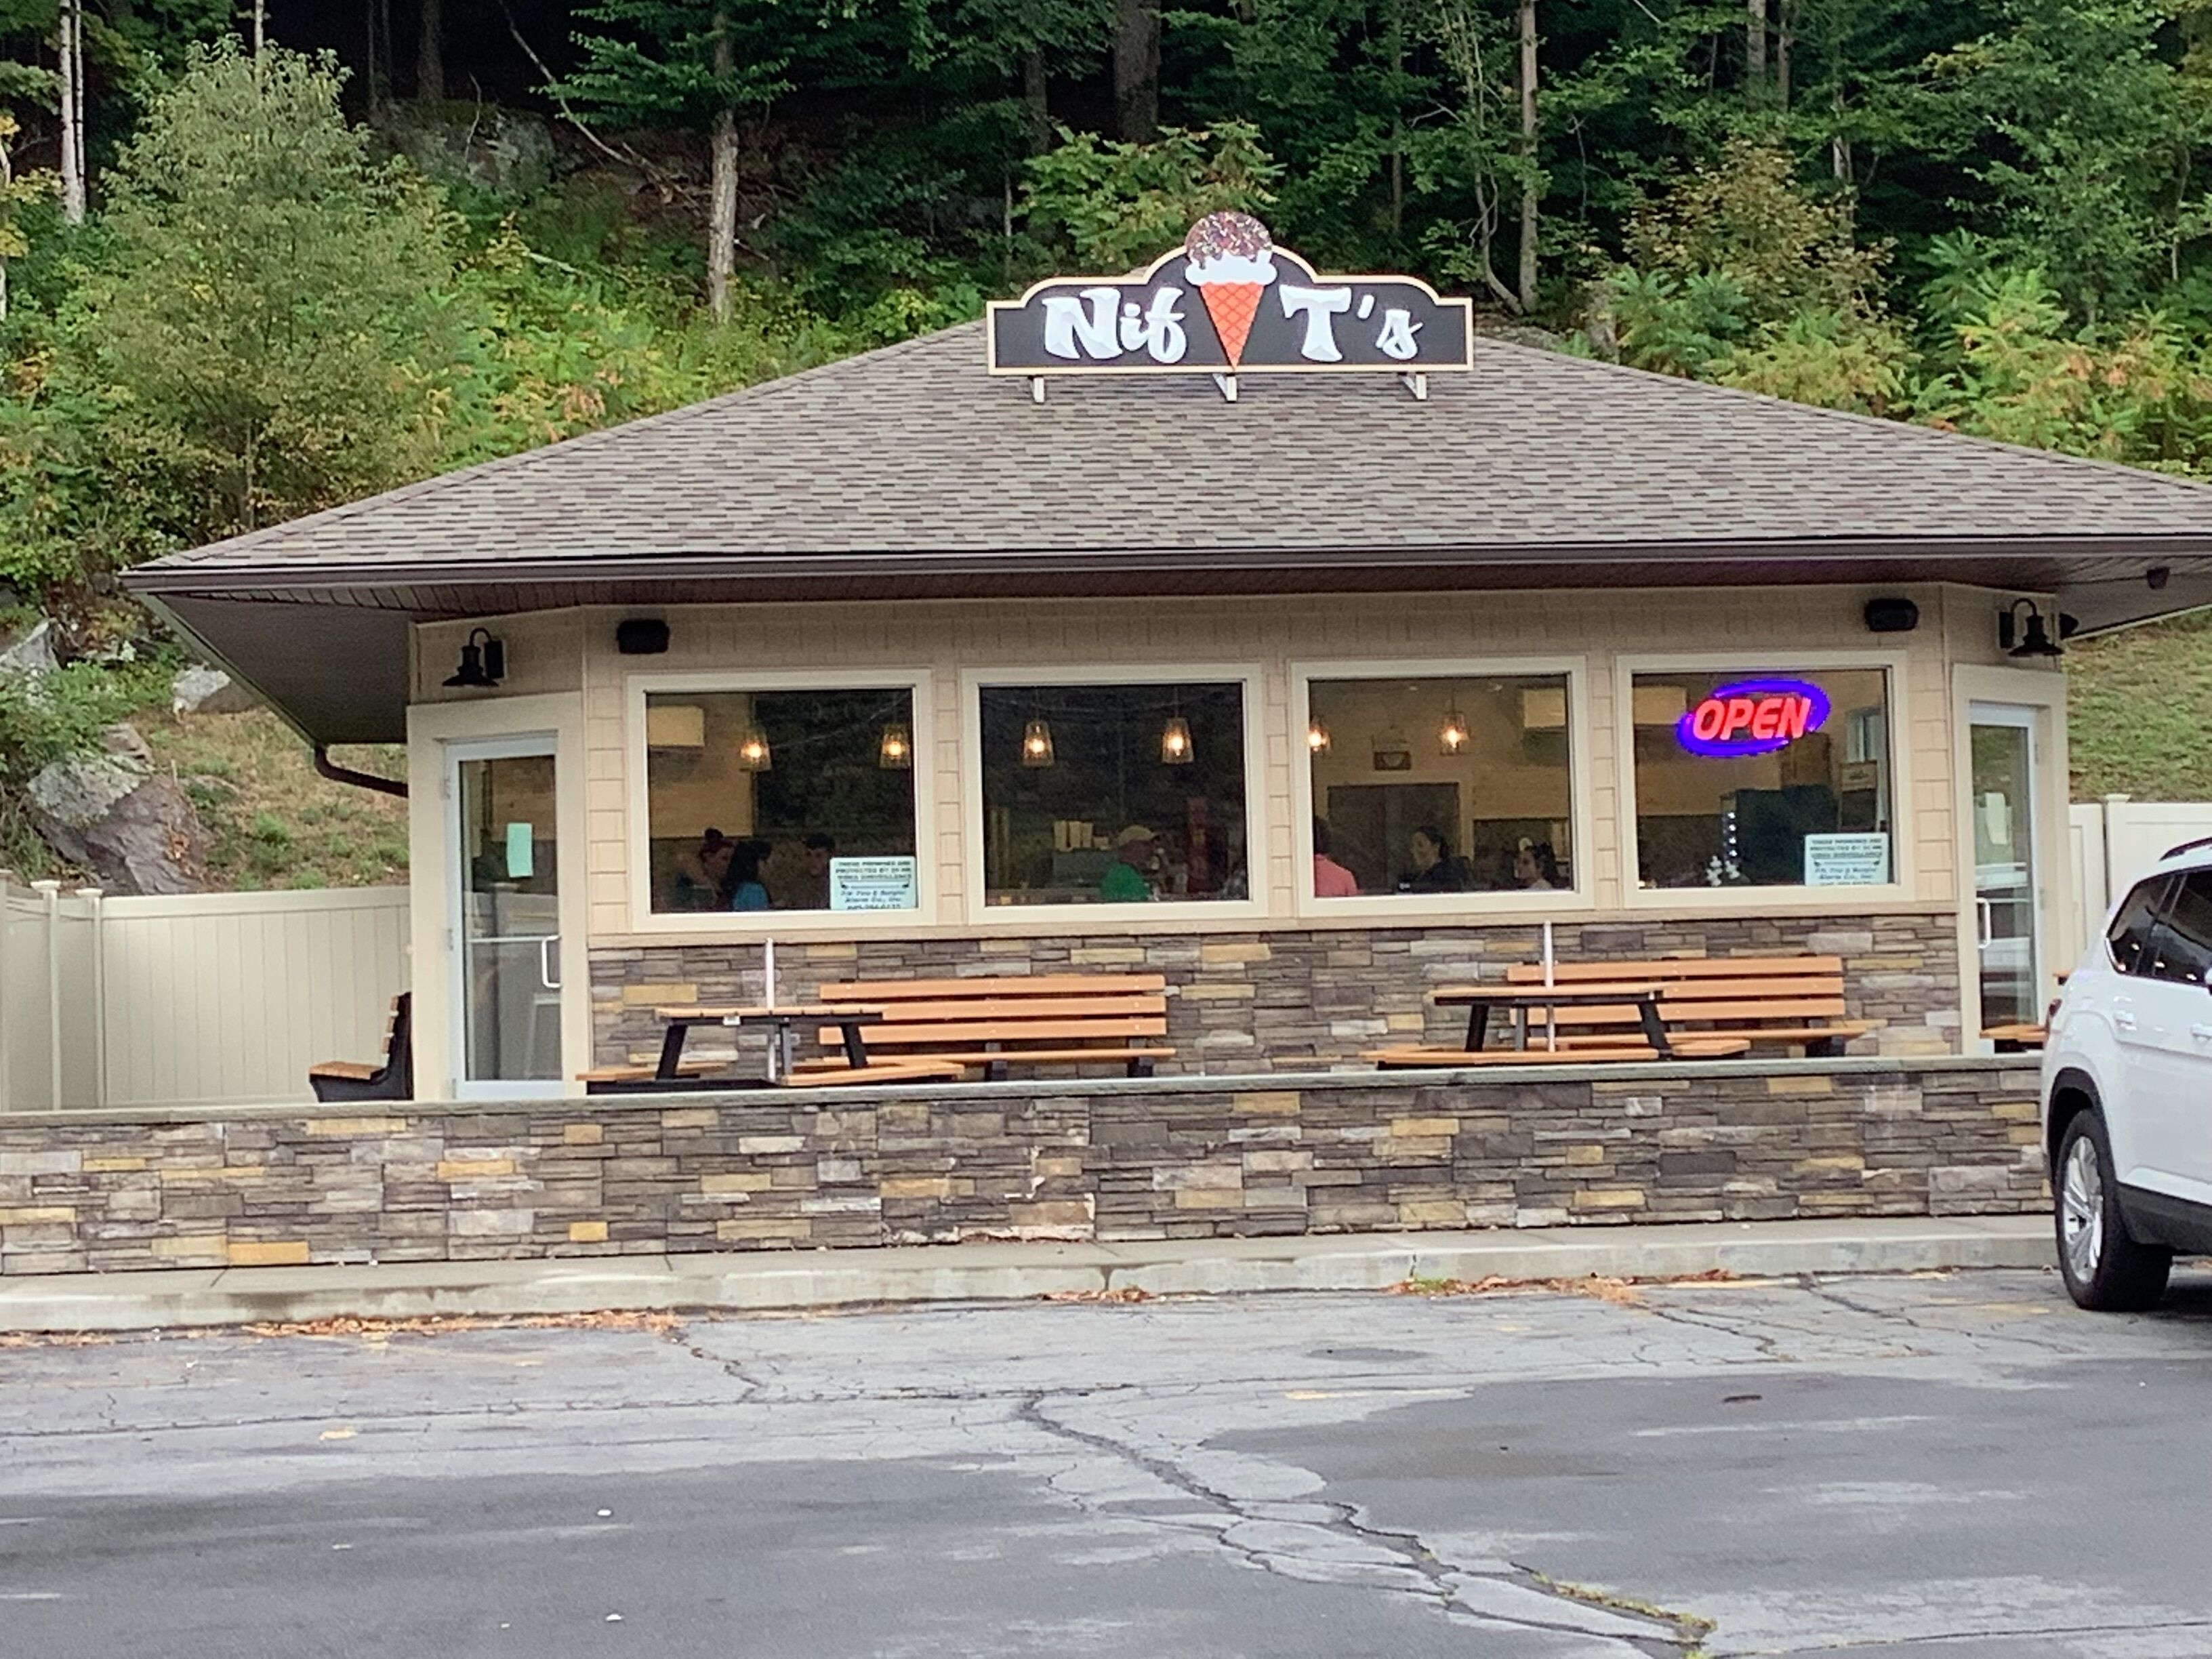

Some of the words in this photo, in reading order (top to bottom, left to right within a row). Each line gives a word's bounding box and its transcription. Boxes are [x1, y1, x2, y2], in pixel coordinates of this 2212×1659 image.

[1042, 286, 1187, 364] Nif
[1279, 283, 1423, 363] T's
[1693, 697, 1811, 740] OPEN
